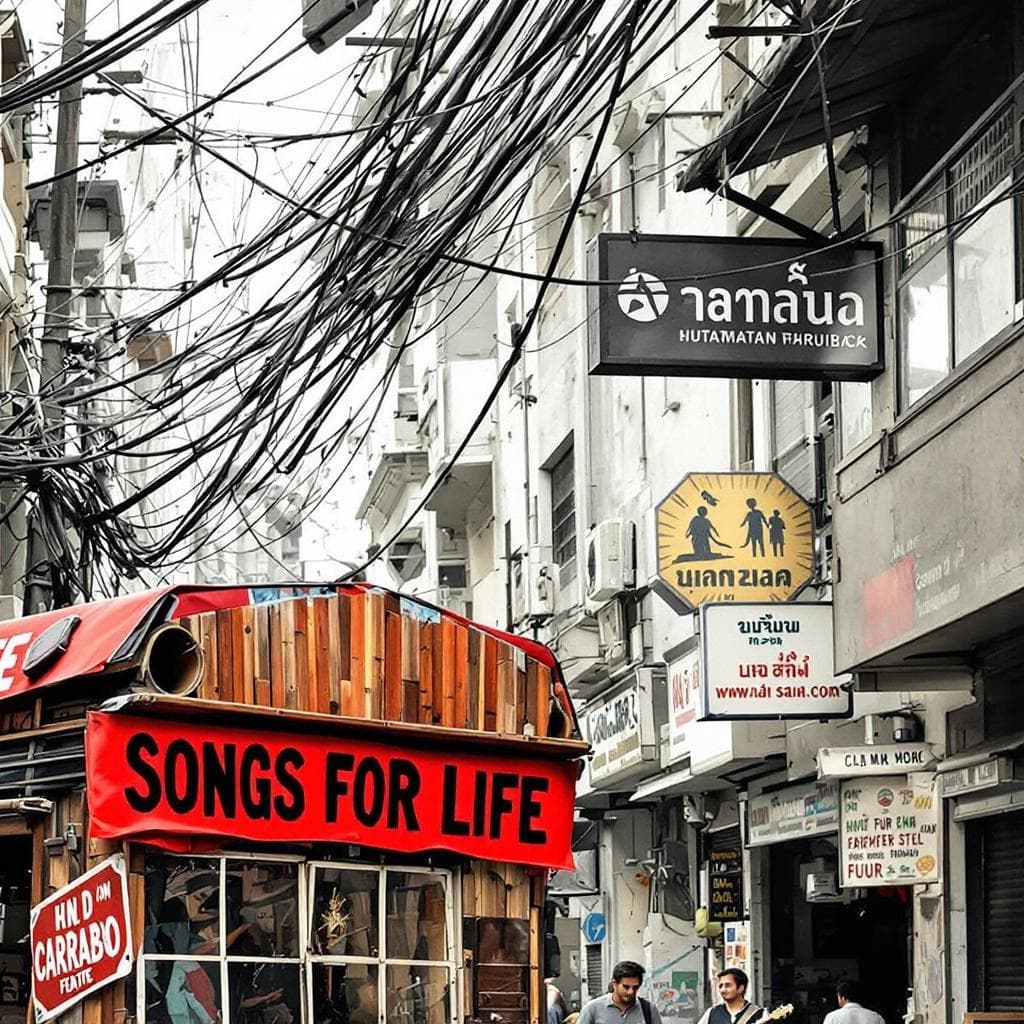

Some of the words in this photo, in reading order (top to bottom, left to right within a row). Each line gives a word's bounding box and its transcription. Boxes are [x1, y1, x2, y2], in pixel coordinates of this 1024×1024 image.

[124, 732, 306, 822] SONGS
[325, 751, 421, 832] FOR
[441, 764, 550, 845] LIFE
